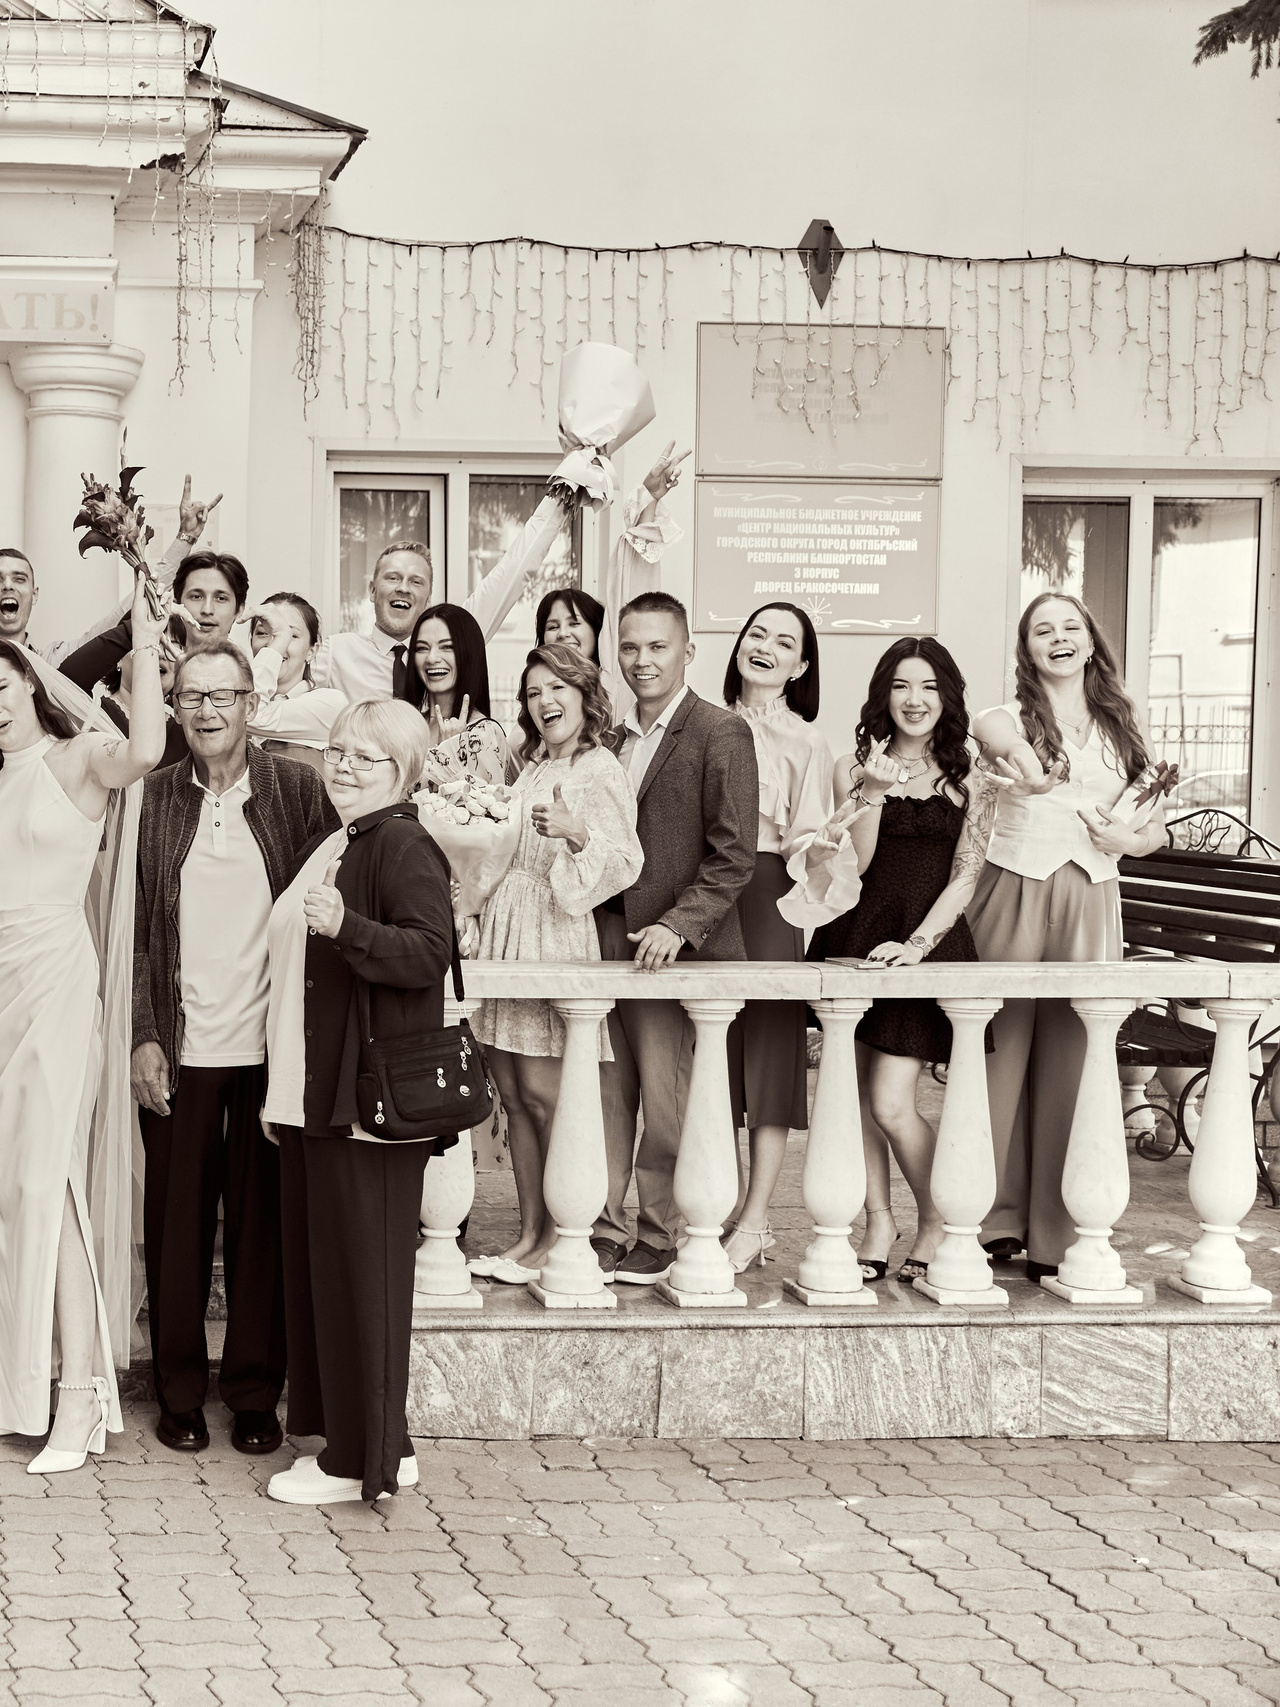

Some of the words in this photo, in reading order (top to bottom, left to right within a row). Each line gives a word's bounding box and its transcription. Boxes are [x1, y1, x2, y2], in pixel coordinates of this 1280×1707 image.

[713, 507, 797, 520] МУНИЦИПАЛЬНОЕ
[798, 508, 859, 521] БЮДЖЕТНОЕ
[860, 509, 922, 522] УЧРЕЖДЕНИЕ
[773, 523, 853, 535] НАЦИОНАЛЬНЫХ
[716, 536, 778, 549] ГОРОДСКОГО
[780, 537, 815, 549] ОКРУГА
[816, 538, 848, 551] ГОРОД
[849, 538, 918, 551] ОКТЯБРЬСКИЙ
[747, 552, 808, 564] РЕСПУБЛИКИ
[810, 553, 887, 565] БАШКОРТОСТАН
[802, 567, 840, 579] КОРПУС
[753, 581, 793, 594] ДВОРЕЦ
[793, 582, 880, 594] БРАКОСОЧЕТАНИЯ
